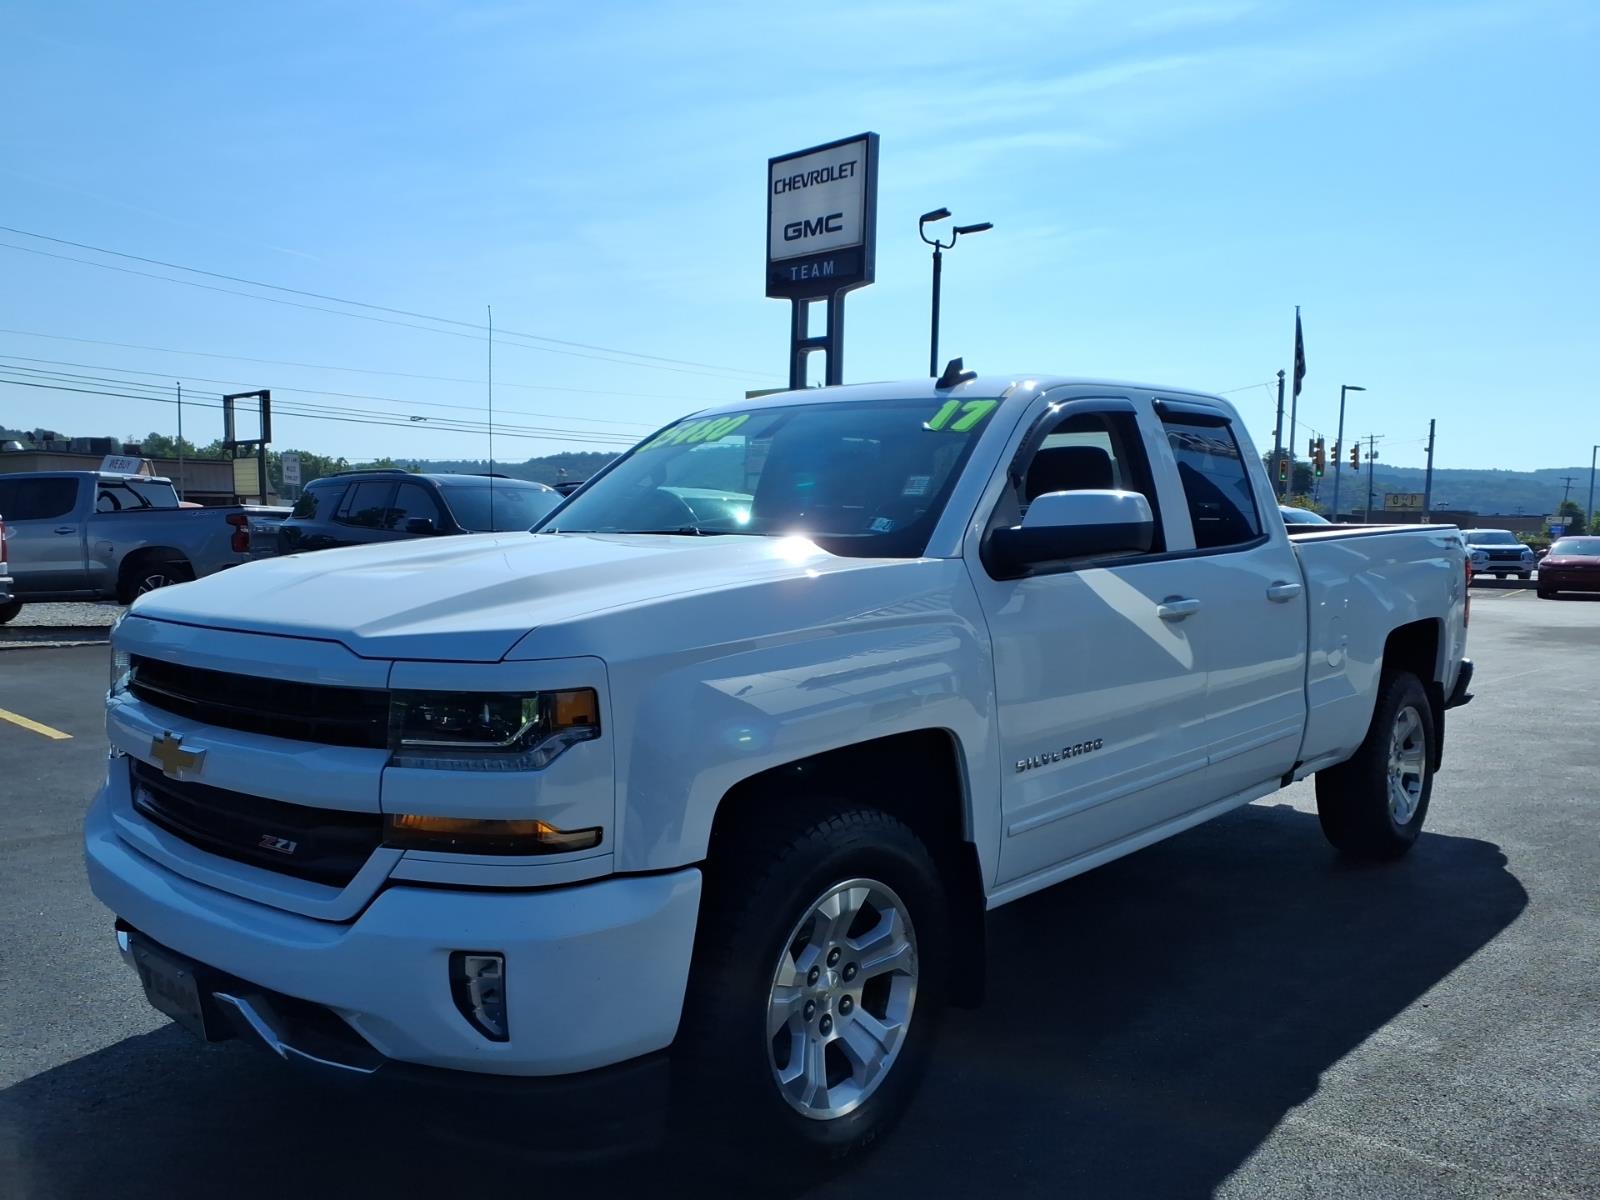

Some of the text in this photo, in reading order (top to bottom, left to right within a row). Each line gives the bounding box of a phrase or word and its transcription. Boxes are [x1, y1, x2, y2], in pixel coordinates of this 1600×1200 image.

[774, 160, 857, 195] CHEVROLET
[784, 212, 843, 241] GMC
[790, 260, 835, 281] TEAM
[926, 399, 998, 432] 17
[1015, 738, 1103, 774] SILVERADO
[259, 834, 297, 855] Z71
